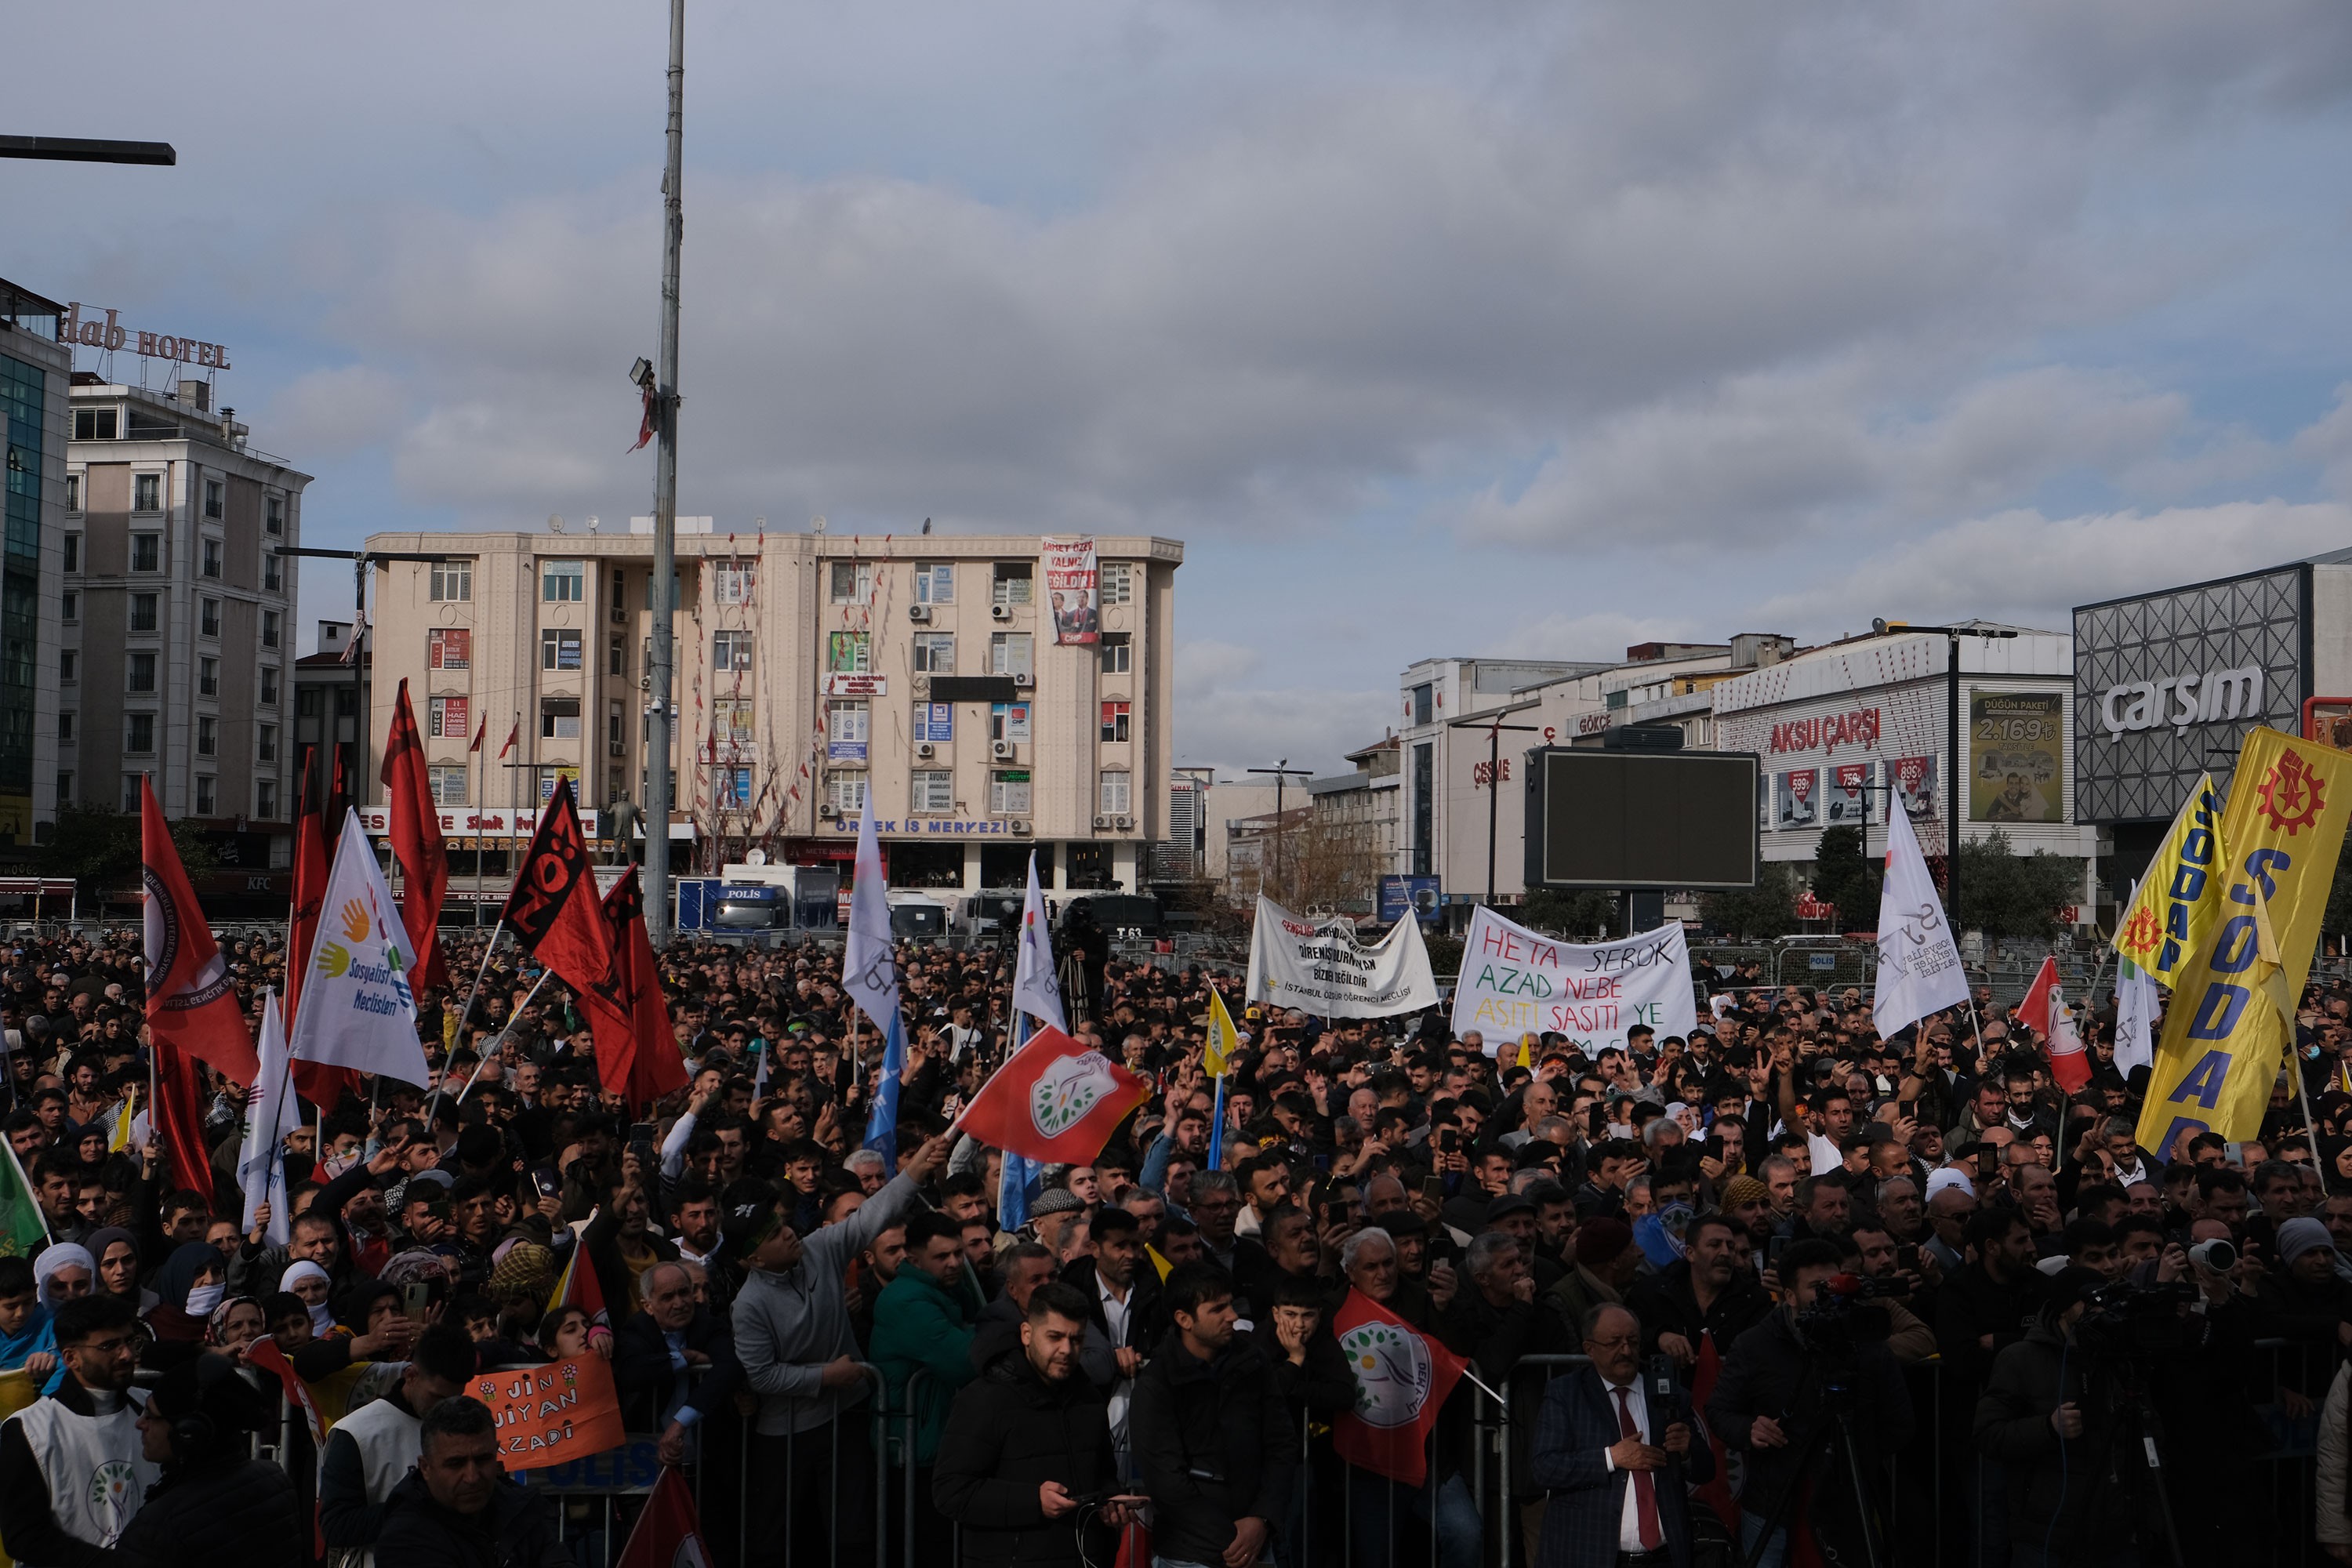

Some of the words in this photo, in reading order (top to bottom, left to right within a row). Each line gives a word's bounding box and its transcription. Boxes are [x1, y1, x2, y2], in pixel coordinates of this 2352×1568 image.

[137, 331, 230, 370] HOTEL
[1051, 557, 1082, 568] YALNIZ
[1049, 572, 1087, 588] EĞİLDİR
[1984, 699, 2018, 710] DÜĞÜN
[2020, 699, 2049, 710] PAKETİ
[2102, 666, 2263, 742] çarşım
[1544, 726, 1555, 742] Ç
[1579, 713, 1611, 734] GÖKÇE
[1769, 713, 1819, 753] AKSU
[1822, 708, 1880, 755] ÇARŞI
[1998, 742, 2035, 751] TAKSİTLE
[466, 815, 503, 829] Simit
[836, 820, 896, 832] ÖREK
[928, 820, 1008, 833] MERKEZİ
[247, 877, 271, 891] KFC
[2157, 790, 2218, 972] SODAP
[728, 888, 760, 898] POLİS
[1128, 927, 1142, 938] 63
[1584, 938, 1674, 972] SEROK
[349, 957, 391, 985] Sosyalist
[1334, 970, 1367, 988] DEĞİLDİR
[1284, 981, 1321, 1000] İSTANBUL
[1381, 985, 1411, 1004] MECLİSİ
[1476, 964, 1552, 998] AZAD
[1564, 975, 1623, 1000] NEBE
[354, 989, 397, 1017] Meclisleri
[1634, 1002, 1664, 1025] YE
[1417, 1362, 1427, 1388] DEM
